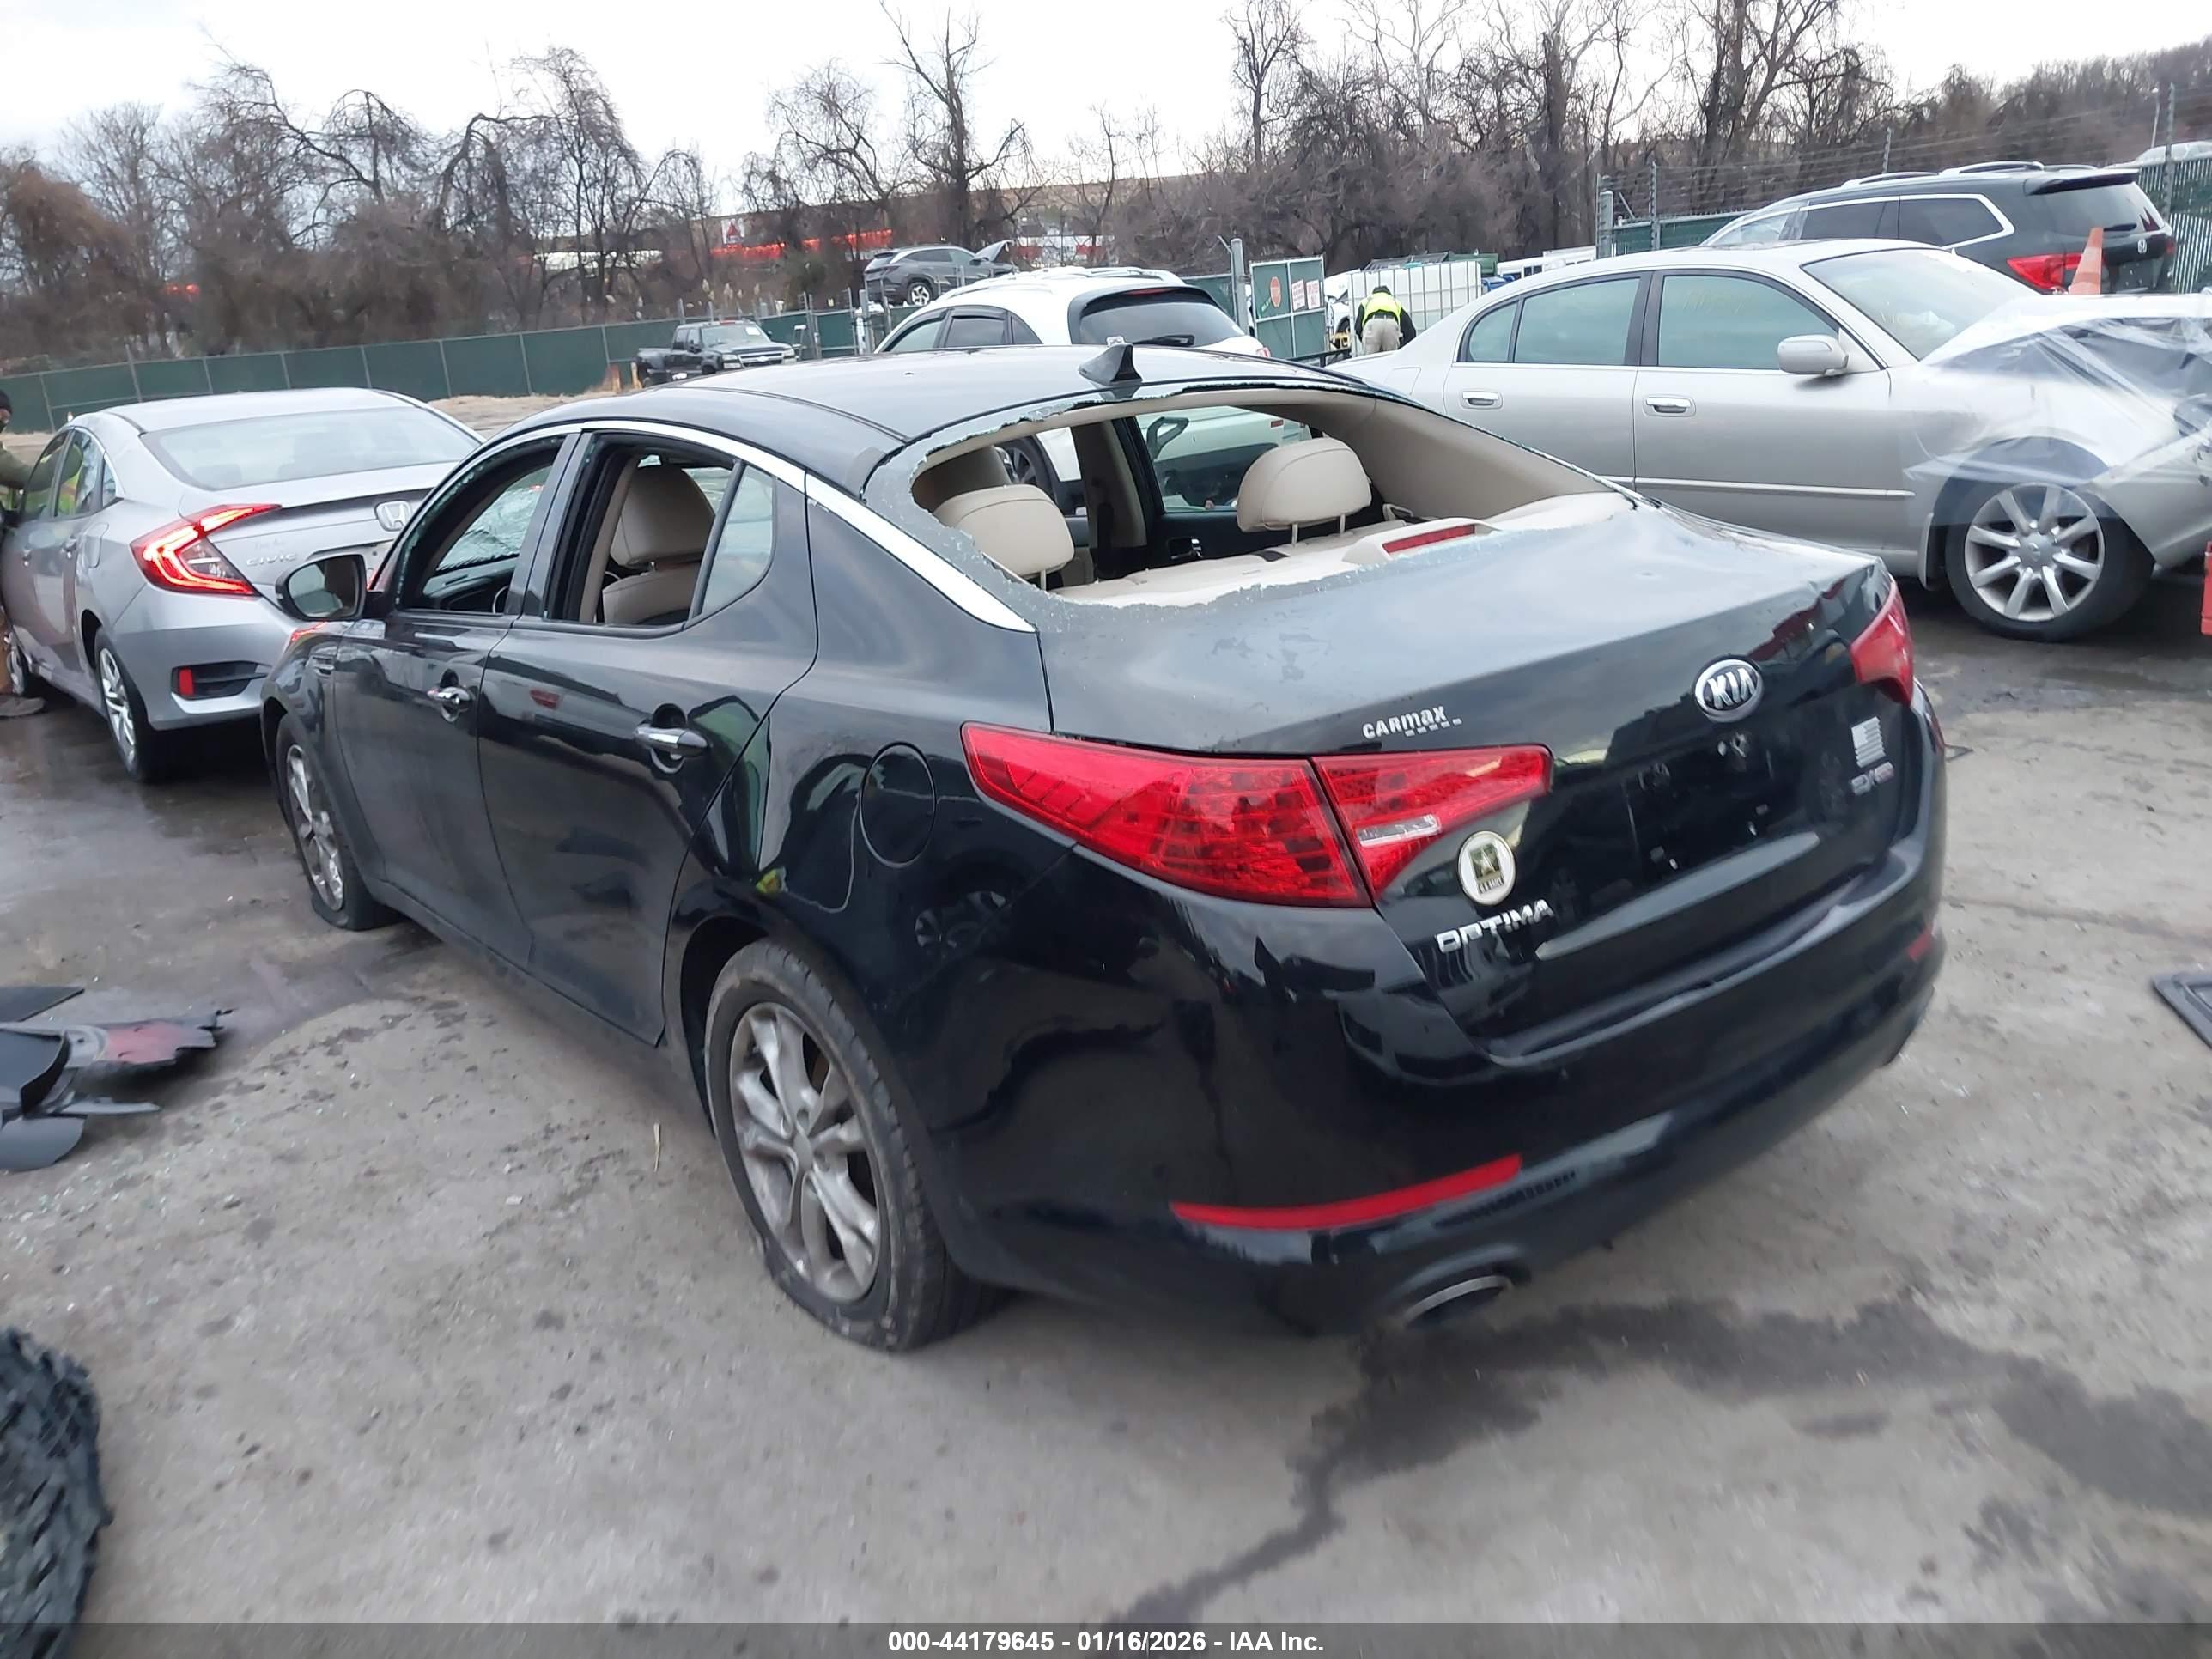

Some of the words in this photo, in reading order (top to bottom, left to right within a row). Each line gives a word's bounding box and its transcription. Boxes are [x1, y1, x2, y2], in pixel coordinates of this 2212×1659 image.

[246, 551, 297, 567] CIVIC
[1706, 667, 1757, 709] KIA
[1435, 898, 1554, 954] OPTIMA
